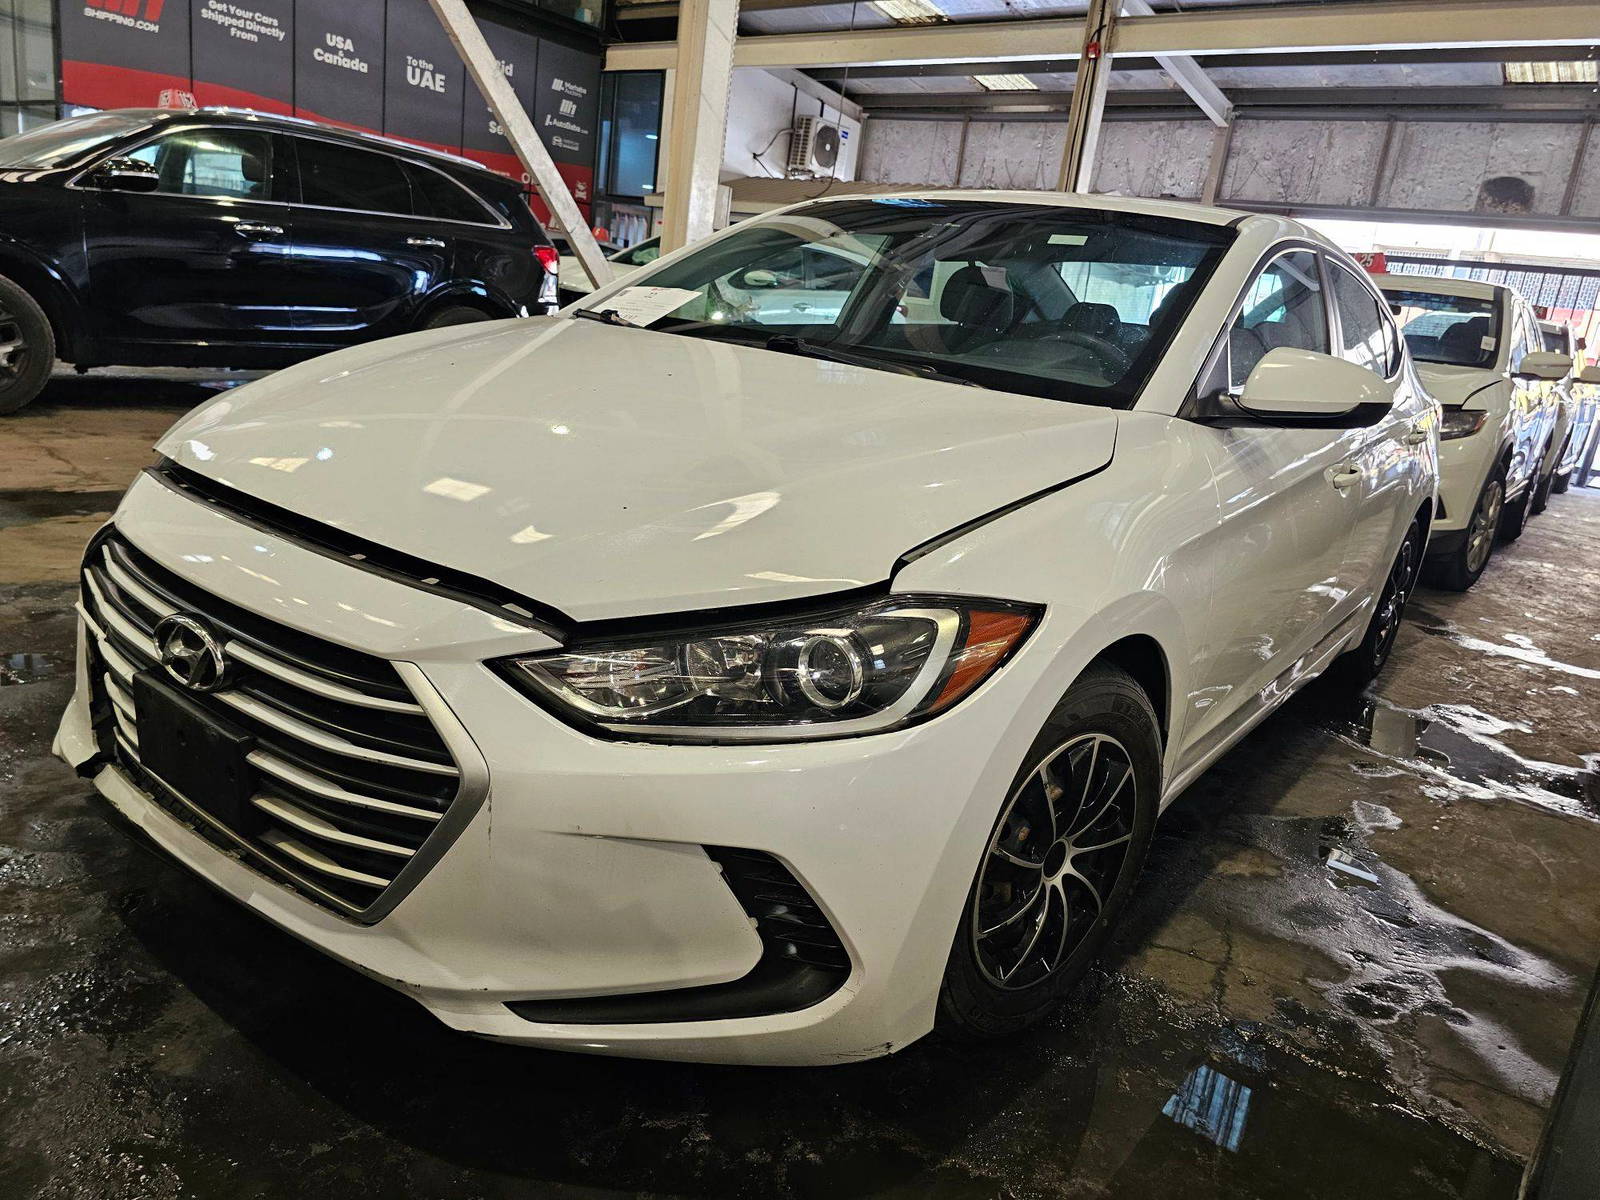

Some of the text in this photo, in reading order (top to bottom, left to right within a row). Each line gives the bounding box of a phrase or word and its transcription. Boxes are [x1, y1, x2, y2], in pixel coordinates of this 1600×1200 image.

[83, 7, 159, 33] SHIPPING.COM
[201, 7, 286, 42] Shipped Directly
[208, 0, 279, 27] Get Your Cars
[230, 27, 258, 42] From
[326, 33, 354, 52] USA
[313, 47, 368, 74] Canada
[406, 56, 434, 71] To the
[406, 66, 446, 93] UAE
[1359, 253, 1374, 268] 25
